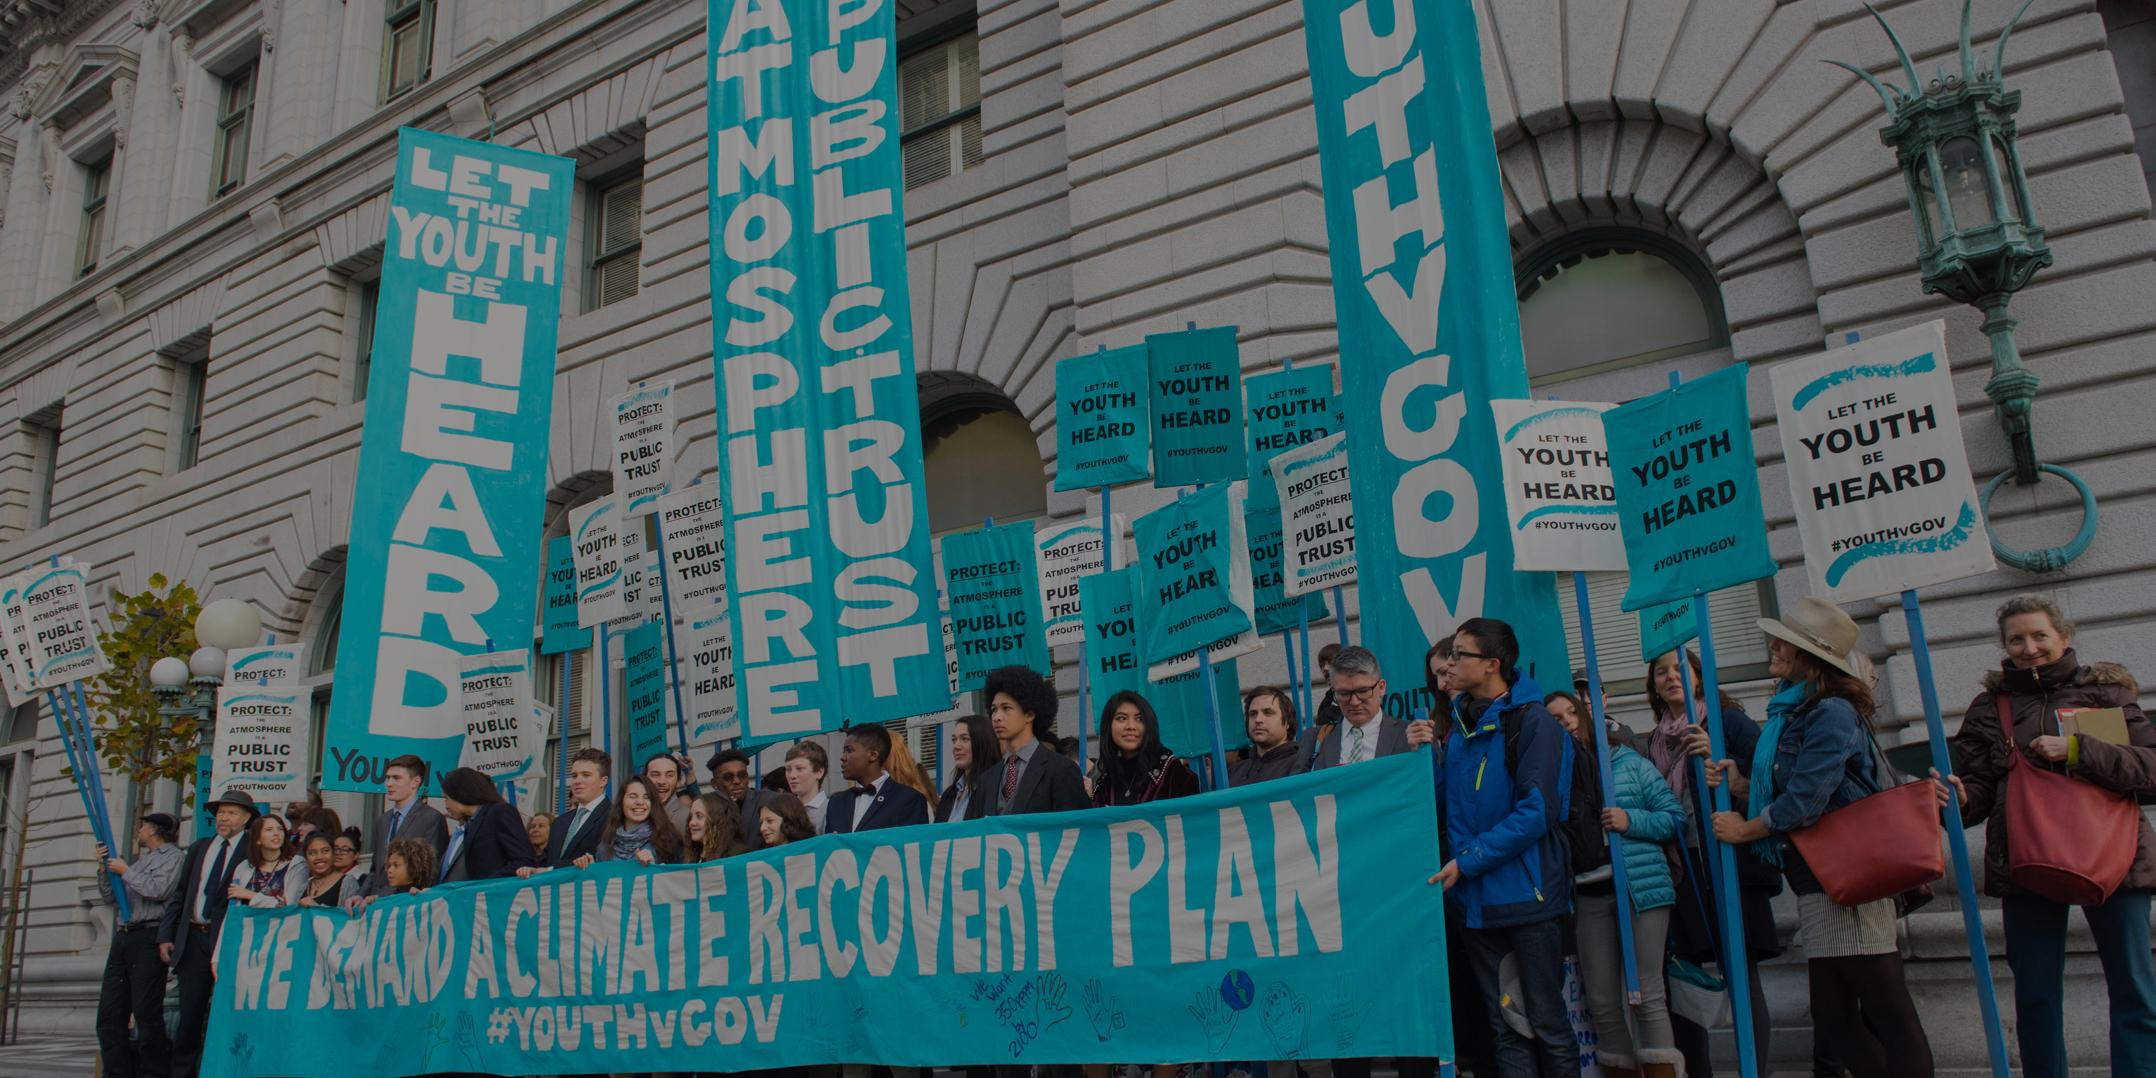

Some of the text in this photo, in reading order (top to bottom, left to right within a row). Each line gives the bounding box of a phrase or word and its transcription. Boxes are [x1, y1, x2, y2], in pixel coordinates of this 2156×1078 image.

[411, 146, 550, 207] LET
[447, 195, 521, 228] THE
[391, 206, 557, 285] YOUTH
[445, 272, 502, 302] BE
[716, 0, 821, 737] ATMOSPHERE
[1174, 362, 1212, 373] LET THE
[1085, 381, 1119, 393] LET THE
[1158, 375, 1229, 397] YOUTH
[1269, 387, 1307, 400] LET THE
[1069, 392, 1135, 415] YOUTH
[1189, 398, 1200, 406] BE
[1253, 398, 1326, 423] YOUTH
[1828, 392, 1897, 420] LET THE
[618, 403, 663, 424] PROTECT:
[1097, 413, 1106, 421] BE
[1161, 408, 1231, 429] HEARD
[1284, 420, 1296, 428] BE
[619, 423, 663, 442] ATMOSPHERE
[1072, 422, 1135, 445] HEARD
[1539, 435, 1587, 444] LET THE
[1652, 420, 1702, 449] LET THE
[1800, 405, 1937, 460] YOUTH
[621, 441, 663, 464] PUBLIC
[1168, 446, 1228, 457] #YOUTHvGOV
[1517, 447, 1610, 467] YOUTH
[1632, 429, 1731, 487] YOUTH
[1862, 451, 1884, 465] BE
[624, 459, 661, 481] TRUST
[1076, 455, 1128, 470] #YOUTHvGOV
[1561, 470, 1576, 478] BE
[1674, 475, 1690, 489] BE
[1812, 457, 1946, 510] HEARD
[1524, 483, 1615, 501] HEARD
[368, 288, 527, 739] HEARD
[665, 497, 722, 521] PROTECT:
[1643, 479, 1736, 534] HEARD
[1535, 521, 1616, 531] #YOUTHvGOV
[1831, 516, 1946, 552] #YOUTHvGOV
[577, 533, 617, 558] YOUTH
[1153, 530, 1216, 570] YOUTH
[1654, 536, 1736, 573] #YOUTHvGOV
[551, 567, 577, 584] YOU
[580, 560, 617, 583] HEARD
[951, 560, 1021, 580] PROTECT:
[1184, 560, 1195, 570] BE
[684, 583, 726, 600] #YOUTHvG
[953, 587, 1023, 605] ATMOSPHERE
[1159, 567, 1218, 605] HEAR
[1114, 604, 1132, 614] LET
[957, 611, 1026, 634] PUBLIC
[1167, 606, 1230, 635] #YOUTHvGOV
[38, 620, 84, 643] PUBLIC
[703, 635, 726, 647] LET THE
[44, 637, 86, 658] TRUST
[962, 634, 1025, 655] TRUST
[234, 669, 286, 680] PROTECT:
[462, 676, 512, 691] PROTECT:
[695, 673, 735, 696] HEARD
[231, 705, 292, 715] PROTECT:
[465, 698, 514, 711] ATMOSPHERE
[632, 689, 661, 712] PUBLIC
[229, 726, 292, 734] ATMOSPHERE
[467, 717, 518, 735] PUBLIC
[635, 709, 660, 731] TRUST
[228, 744, 291, 756] PUBLIC
[472, 736, 518, 752] TRUST
[230, 761, 288, 773] TRUST
[227, 783, 287, 791] #YOUTHvGOV
[234, 794, 1343, 1011] WE DEMAND A CLIMATE RECOVERY PLAN
[487, 994, 784, 1051] #YOUTHvGOV
